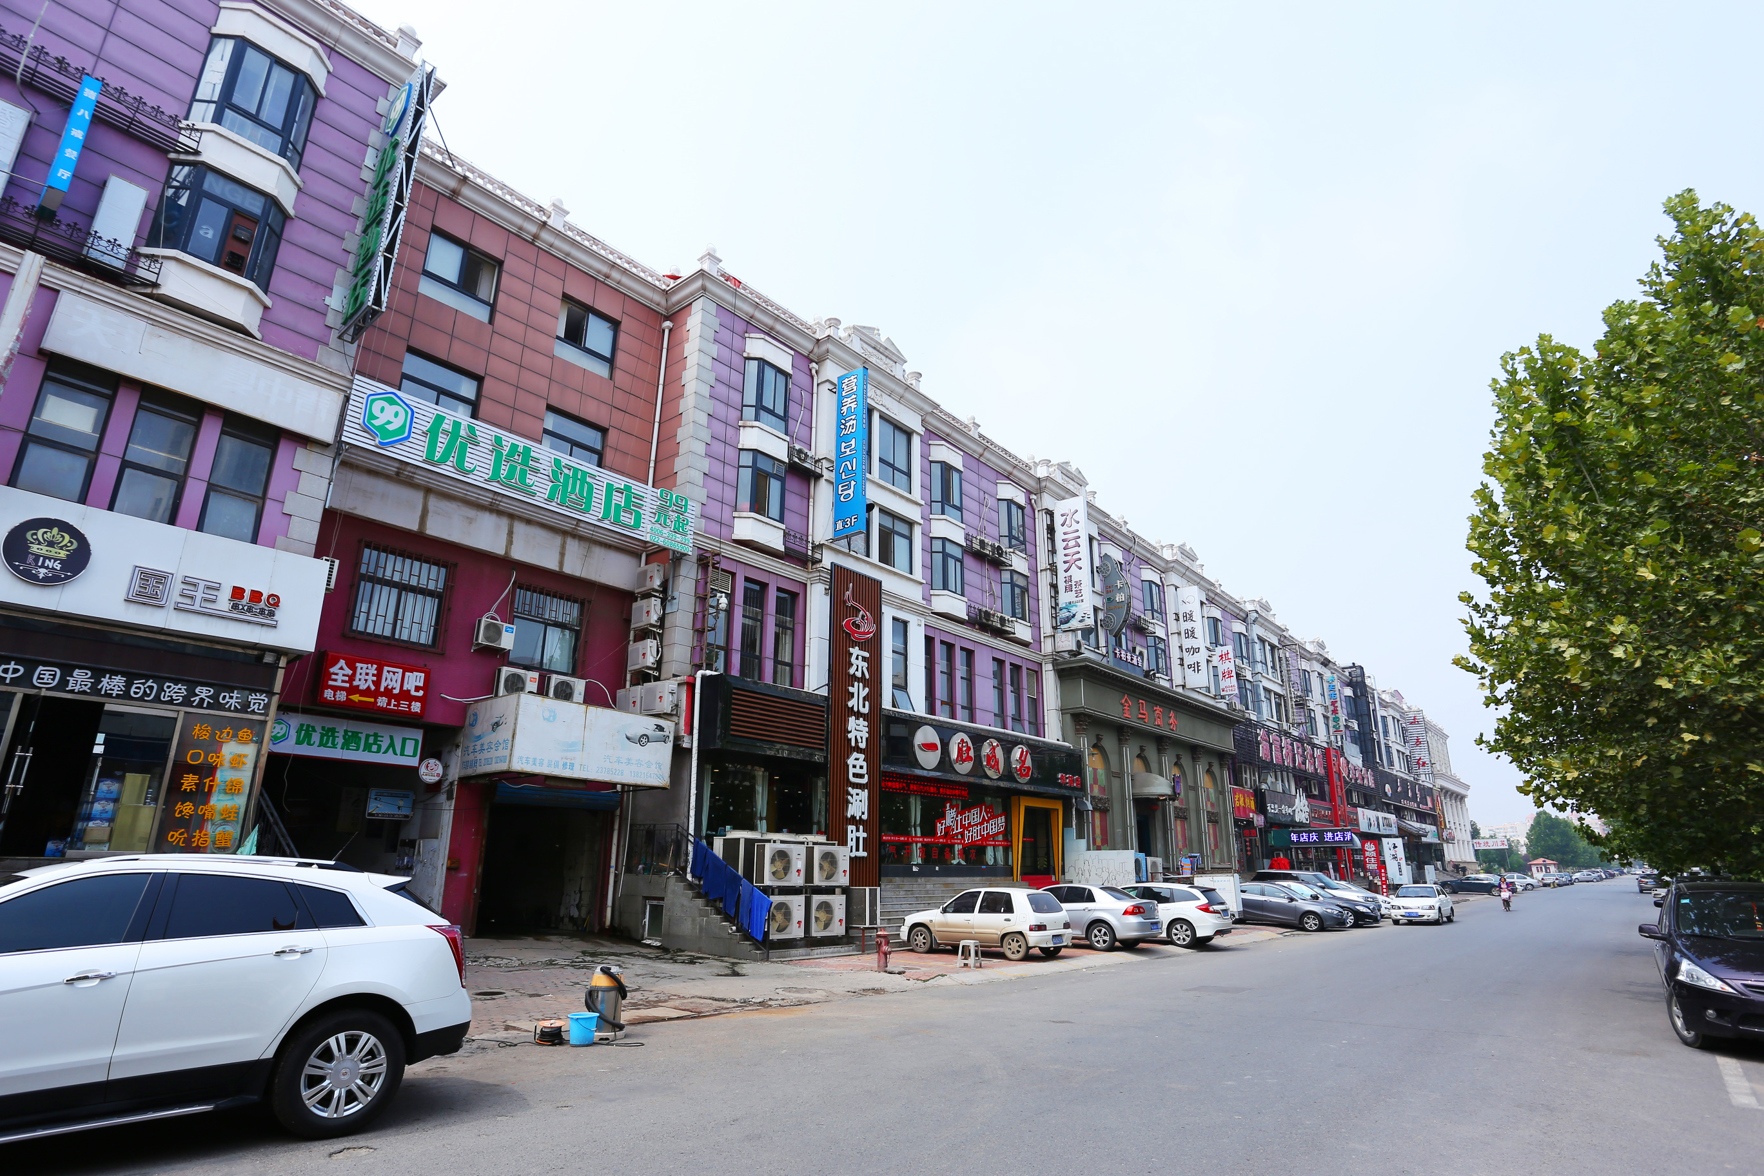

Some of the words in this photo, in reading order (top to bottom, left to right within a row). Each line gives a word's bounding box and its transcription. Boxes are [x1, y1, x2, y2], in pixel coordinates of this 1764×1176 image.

[371, 400, 401, 431] 99
[839, 374, 858, 437] 营养汤
[423, 413, 645, 530] 优选酒店
[658, 488, 689, 514] 99
[654, 506, 690, 536] 元起
[1061, 508, 1082, 573] 水云天
[26, 554, 62, 571] KING
[230, 585, 281, 608] BBQ
[1182, 611, 1202, 674] 暖暖咖啡
[327, 659, 425, 697] 全联网吧
[1218, 650, 1236, 683] 棋牌
[0, 660, 270, 715] 中国最棒的跨界味觉
[323, 689, 347, 702] 电梯
[376, 696, 422, 713] 请上三楼
[192, 723, 253, 744] 梭边鱼
[294, 723, 420, 758] 优选酒店入口
[186, 749, 249, 769] 口味虾
[847, 646, 870, 858] 东北特色涮肚
[181, 774, 245, 794] 素什锦
[175, 802, 240, 821] 馋嘴蛙
[167, 828, 234, 847] 吮指蟹
